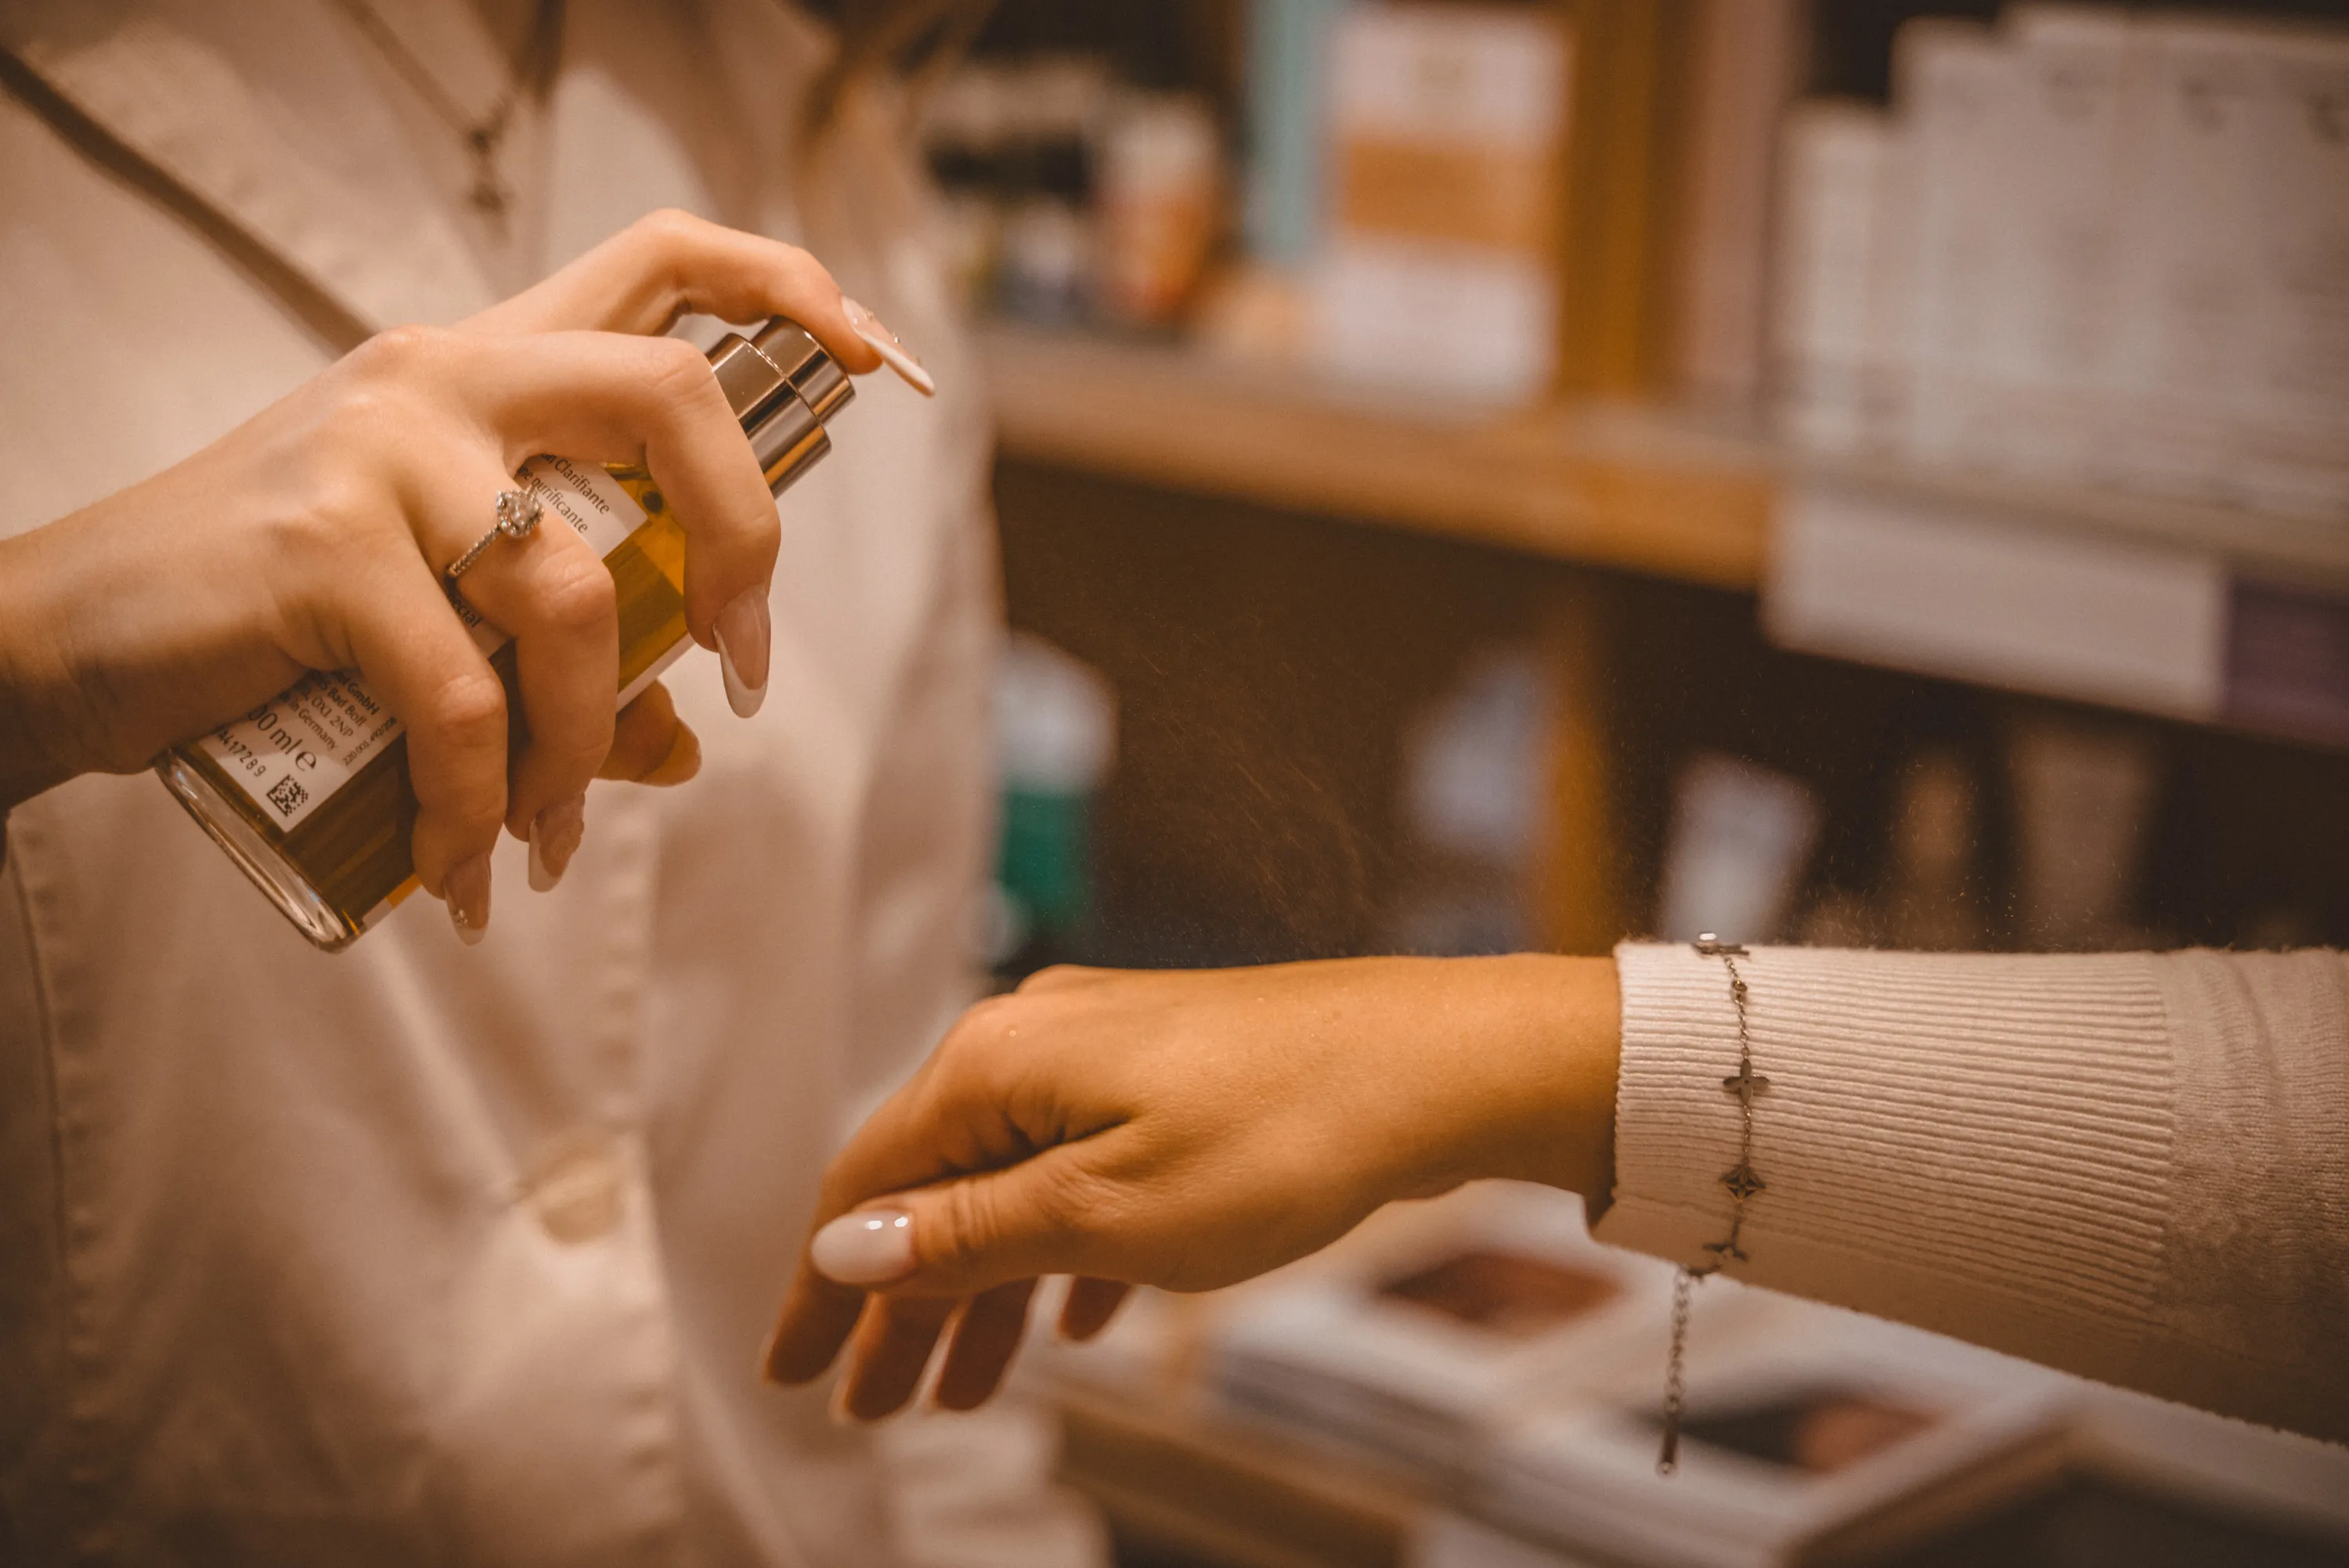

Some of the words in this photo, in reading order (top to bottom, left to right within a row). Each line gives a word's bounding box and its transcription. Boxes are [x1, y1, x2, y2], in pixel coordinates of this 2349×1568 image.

[554, 459, 610, 514] Clarifiante
[530, 477, 589, 534] purificante
[327, 687, 349, 708] Bad
[348, 683, 381, 716] GmbH
[269, 728, 304, 755] ml
[298, 708, 338, 751] Germany
[330, 715, 354, 737] 2NP
